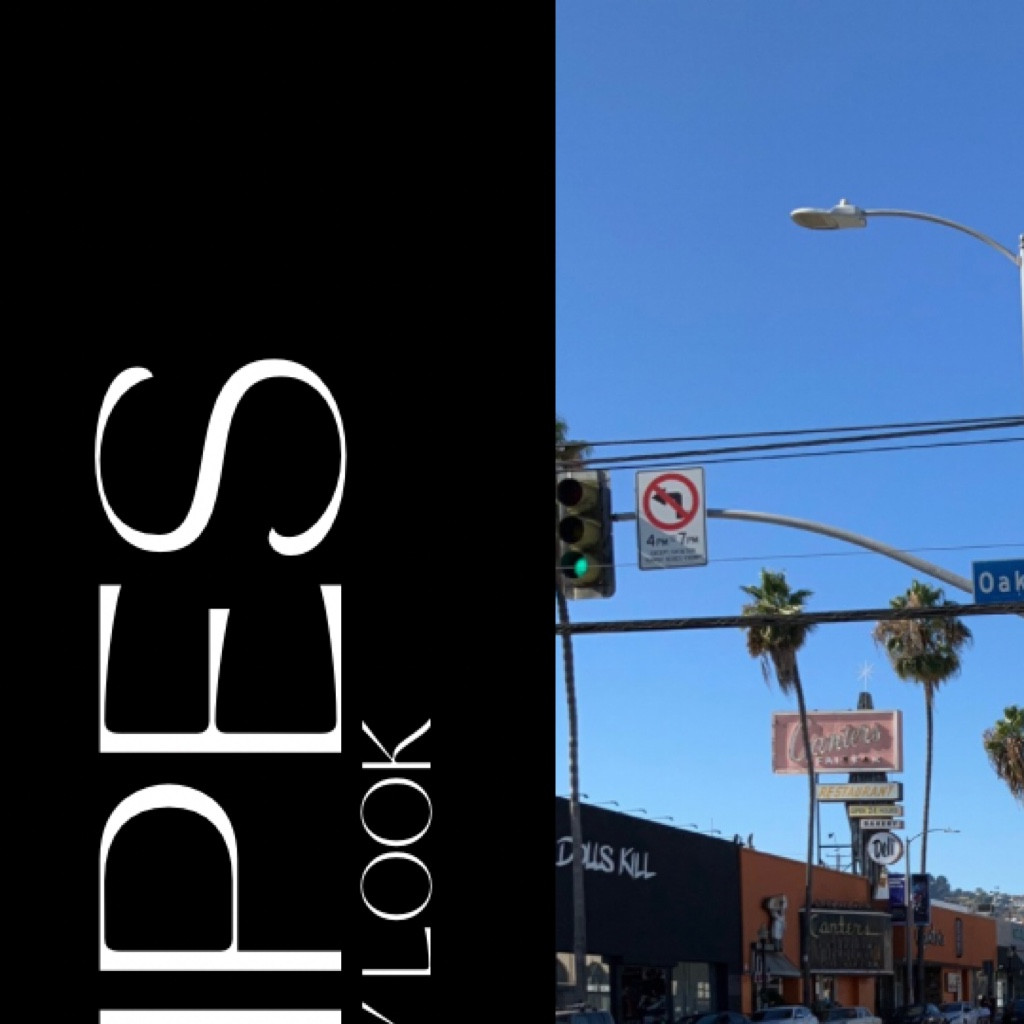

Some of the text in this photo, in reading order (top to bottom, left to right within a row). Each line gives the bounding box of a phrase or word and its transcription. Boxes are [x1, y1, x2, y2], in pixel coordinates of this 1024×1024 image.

[819, 785, 894, 799] RESTAURANT
[555, 836, 658, 879] DLLS KILL
